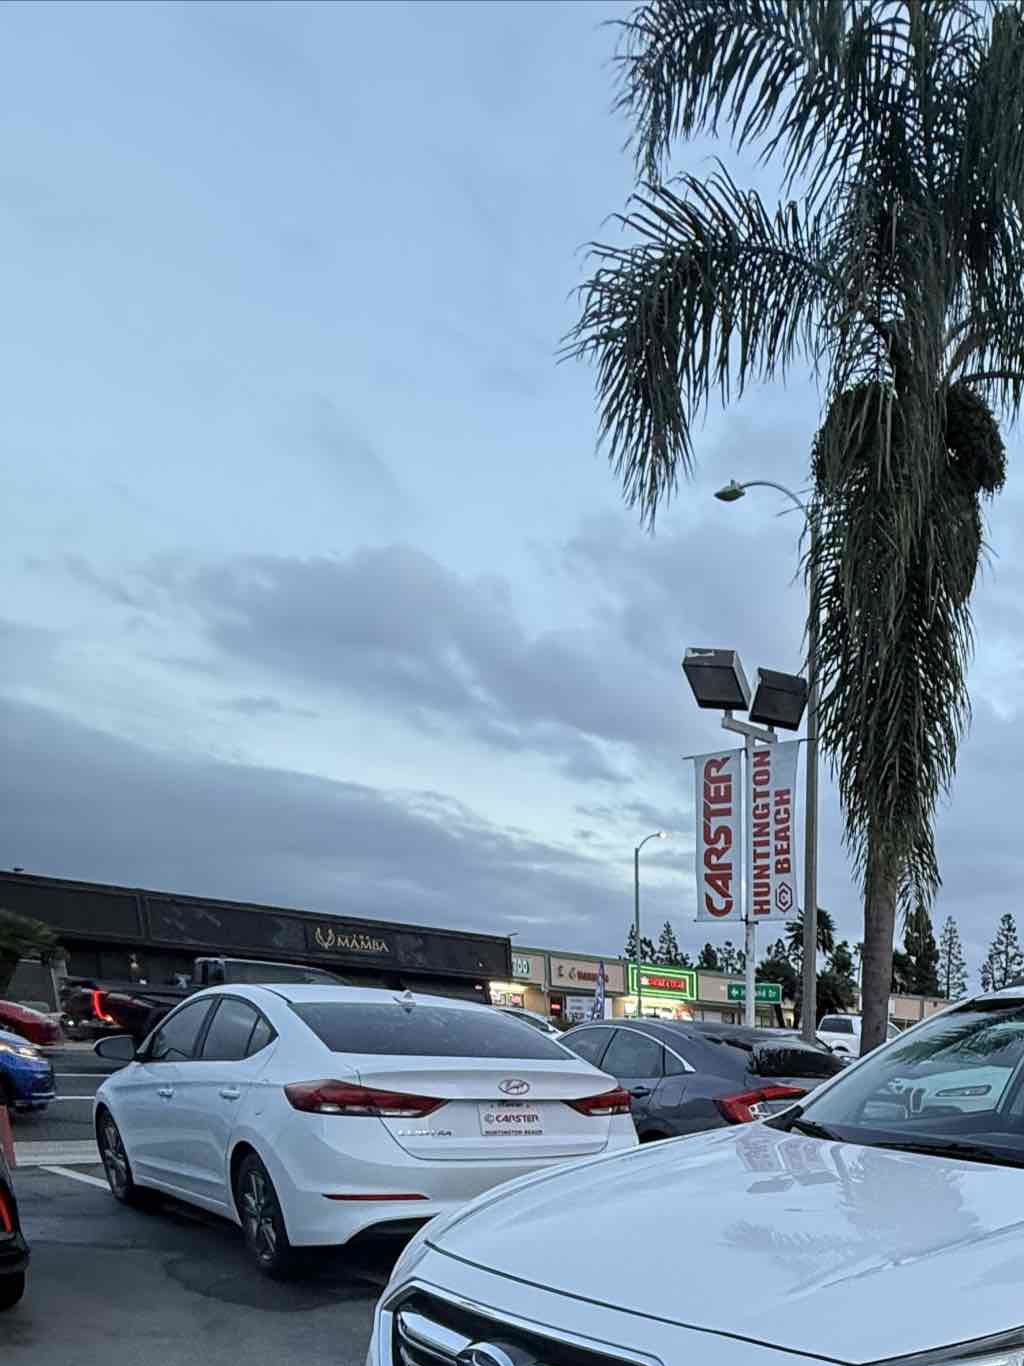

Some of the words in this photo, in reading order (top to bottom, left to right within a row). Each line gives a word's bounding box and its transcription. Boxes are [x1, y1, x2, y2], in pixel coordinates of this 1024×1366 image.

[704, 756, 733, 918] CARSTER
[753, 750, 771, 916] HUNTINGTON
[774, 788, 791, 875] BEACH
[337, 935, 390, 952] MAMBA
[495, 1113, 539, 1123] CARSTER
